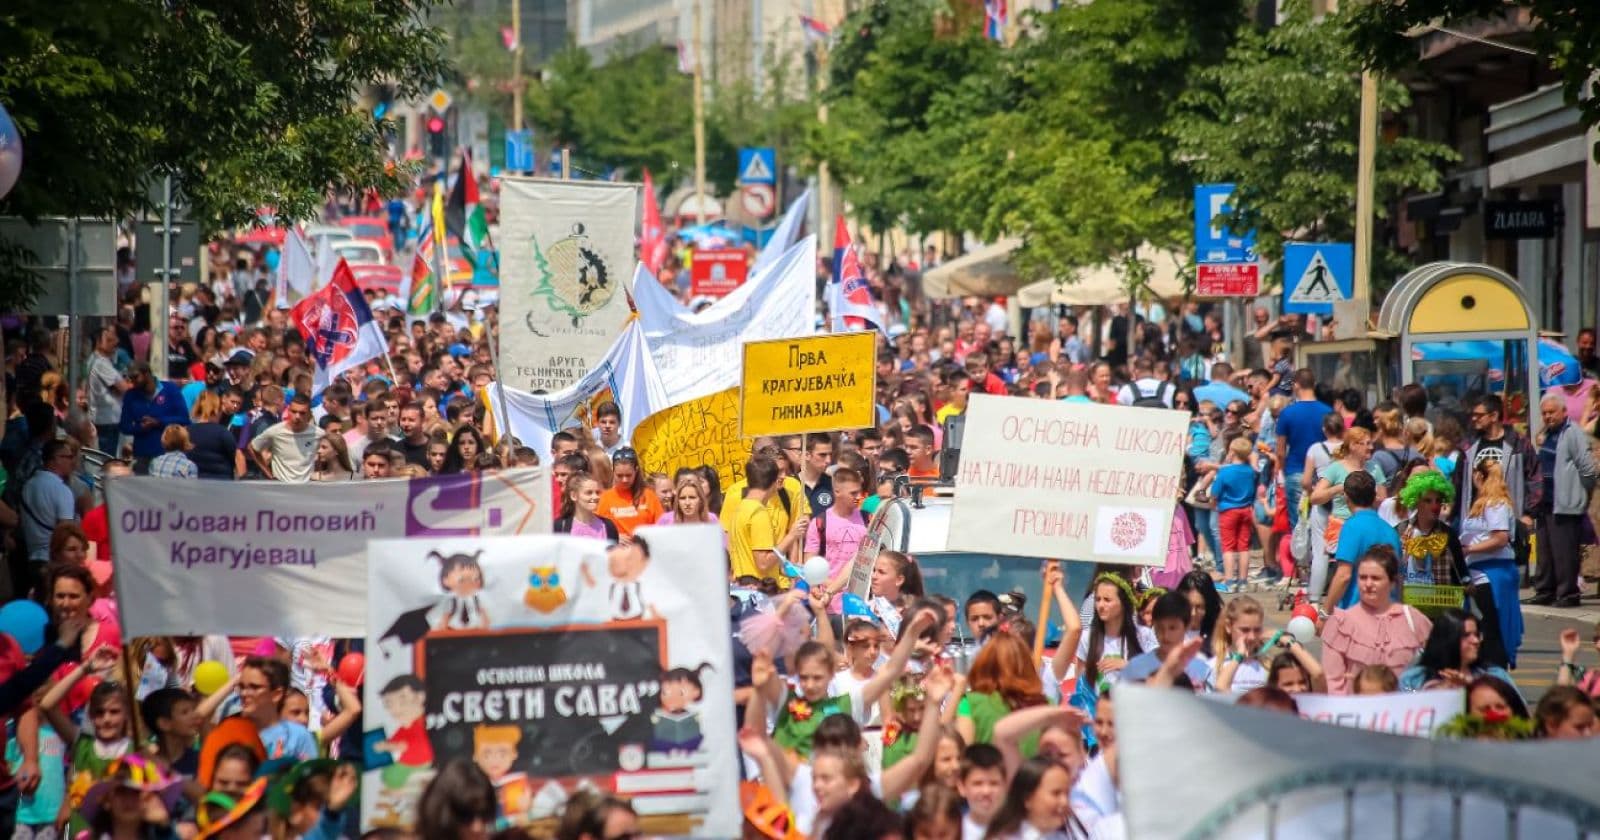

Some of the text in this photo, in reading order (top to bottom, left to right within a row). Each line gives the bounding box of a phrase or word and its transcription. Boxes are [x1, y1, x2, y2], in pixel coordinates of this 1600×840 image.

[1494, 210, 1545, 229] ZLATARA
[1208, 265, 1238, 274] ZONA
[516, 366, 573, 378] ТЕХНИЧКА
[548, 356, 585, 368] ДРУГА
[1002, 415, 1184, 456] ОСНОВНА ШКОЛА
[961, 460, 1038, 489] НАТАЛИЈА
[1043, 464, 1080, 493] НАНА
[121, 510, 162, 533] ОШ
[1012, 508, 1088, 541] ГРОШНИЦА
[171, 541, 316, 570] Крагујевац
[477, 663, 606, 685] ОСНОВНА ШКОЛА
